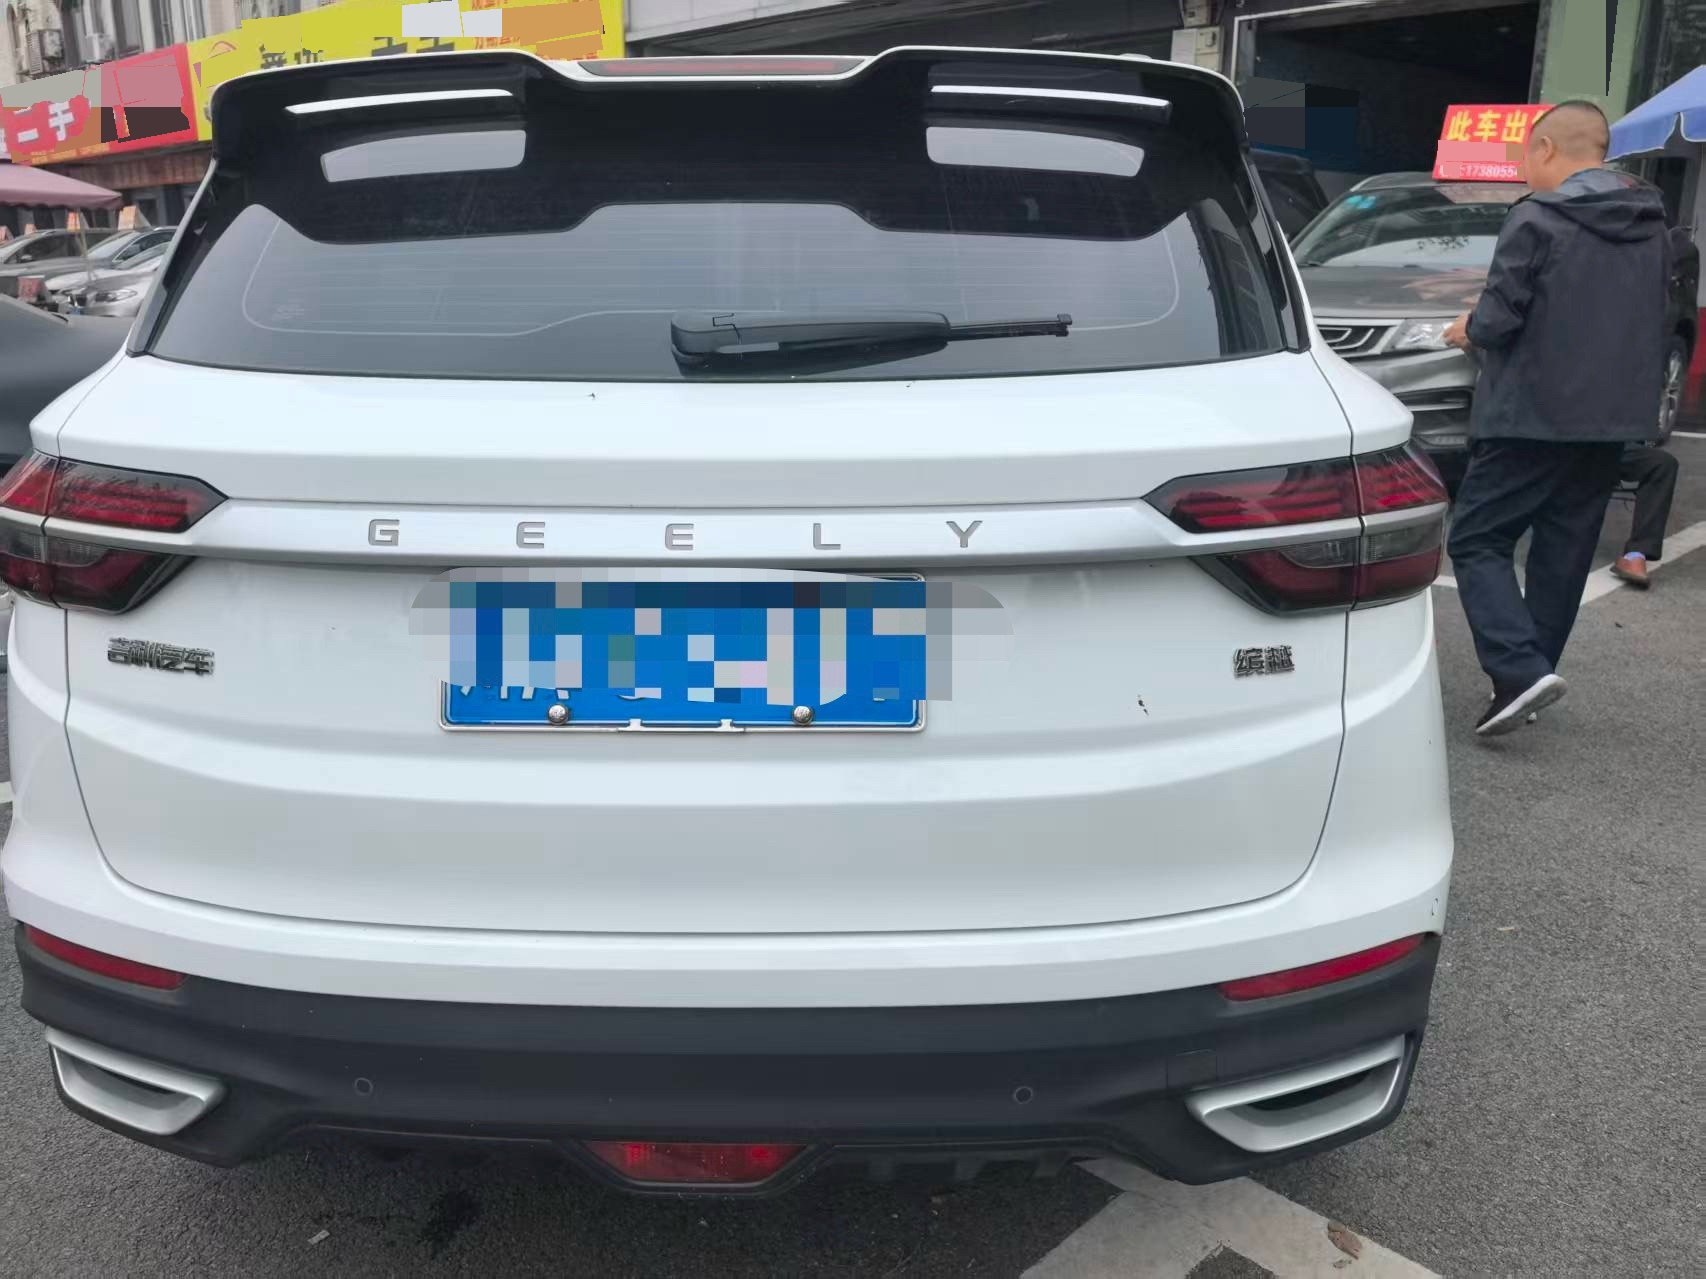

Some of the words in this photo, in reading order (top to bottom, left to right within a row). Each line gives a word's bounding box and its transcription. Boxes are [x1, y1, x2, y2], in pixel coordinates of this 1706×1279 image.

[367, 518, 984, 551] GEELY
[107, 637, 215, 677] 吉利汽车
[1233, 645, 1295, 679] 缤越
